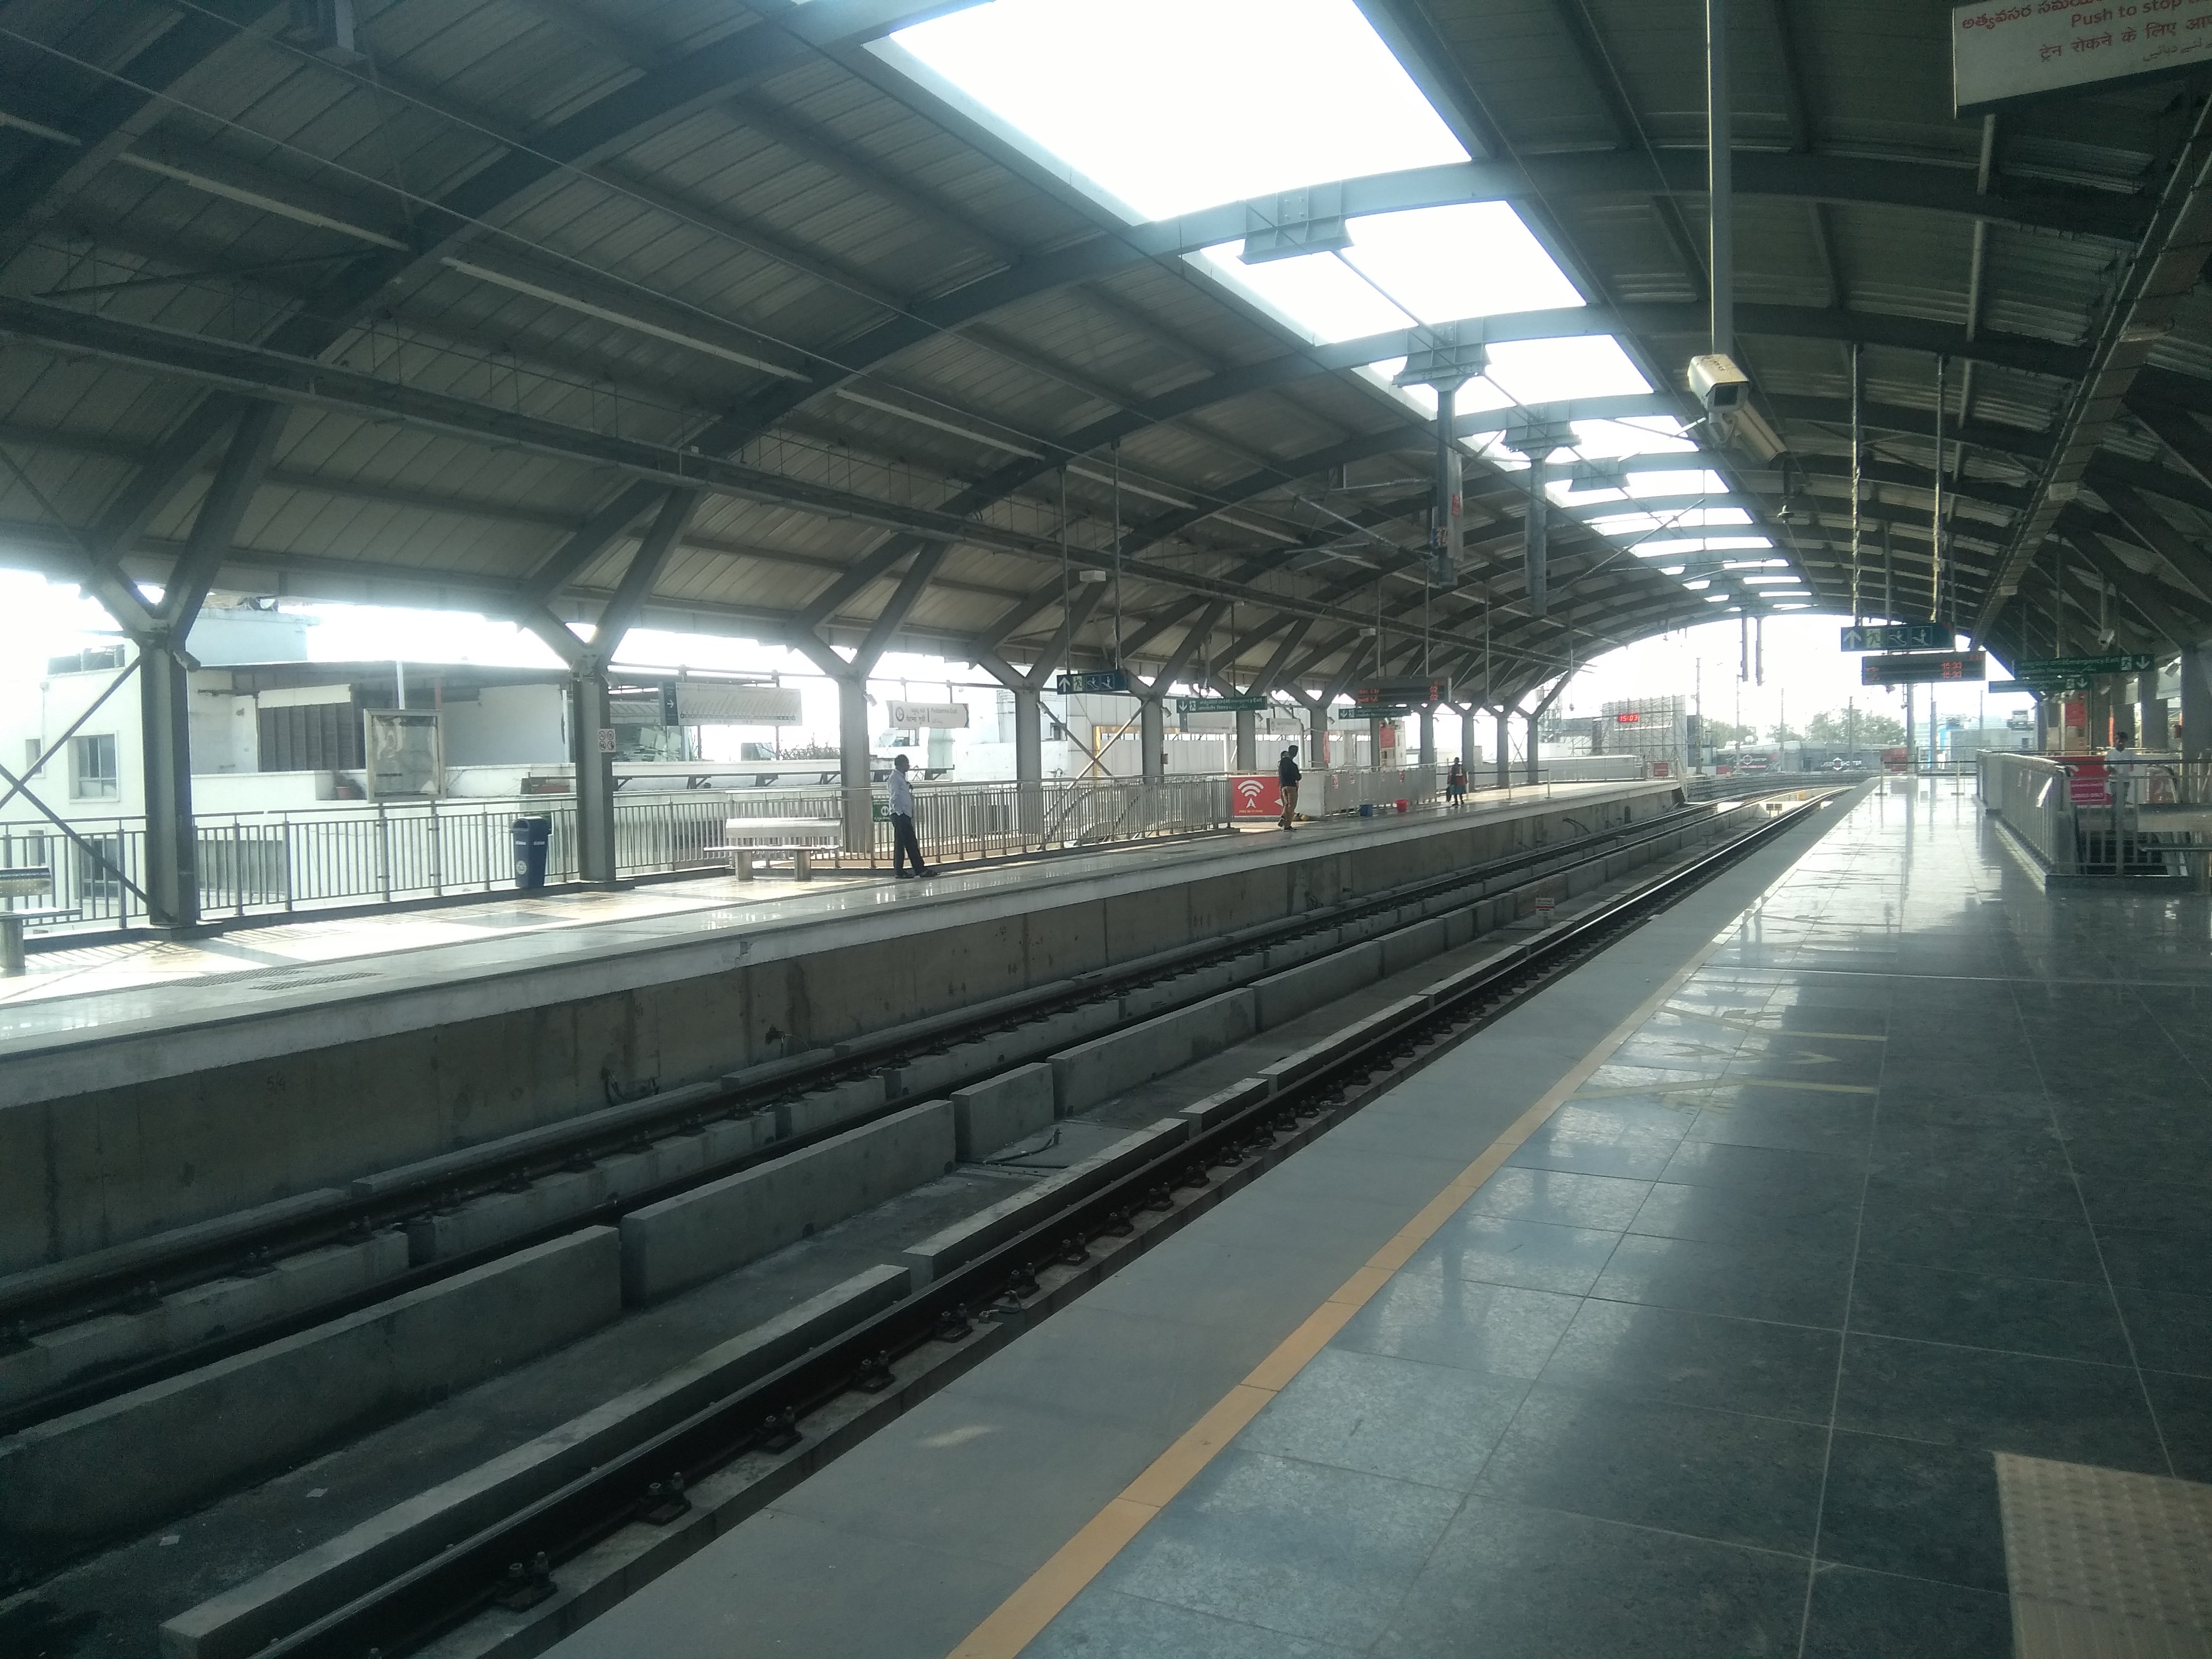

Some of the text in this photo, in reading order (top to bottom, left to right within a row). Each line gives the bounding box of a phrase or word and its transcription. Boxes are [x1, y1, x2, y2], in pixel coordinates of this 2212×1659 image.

[2071, 0, 2181, 27] Push to stop
[2039, 44, 2062, 63] ट्रेन
[2070, 31, 2112, 52] रोकने
[2121, 27, 2136, 43] के
[2145, 22, 2176, 39] लिए
